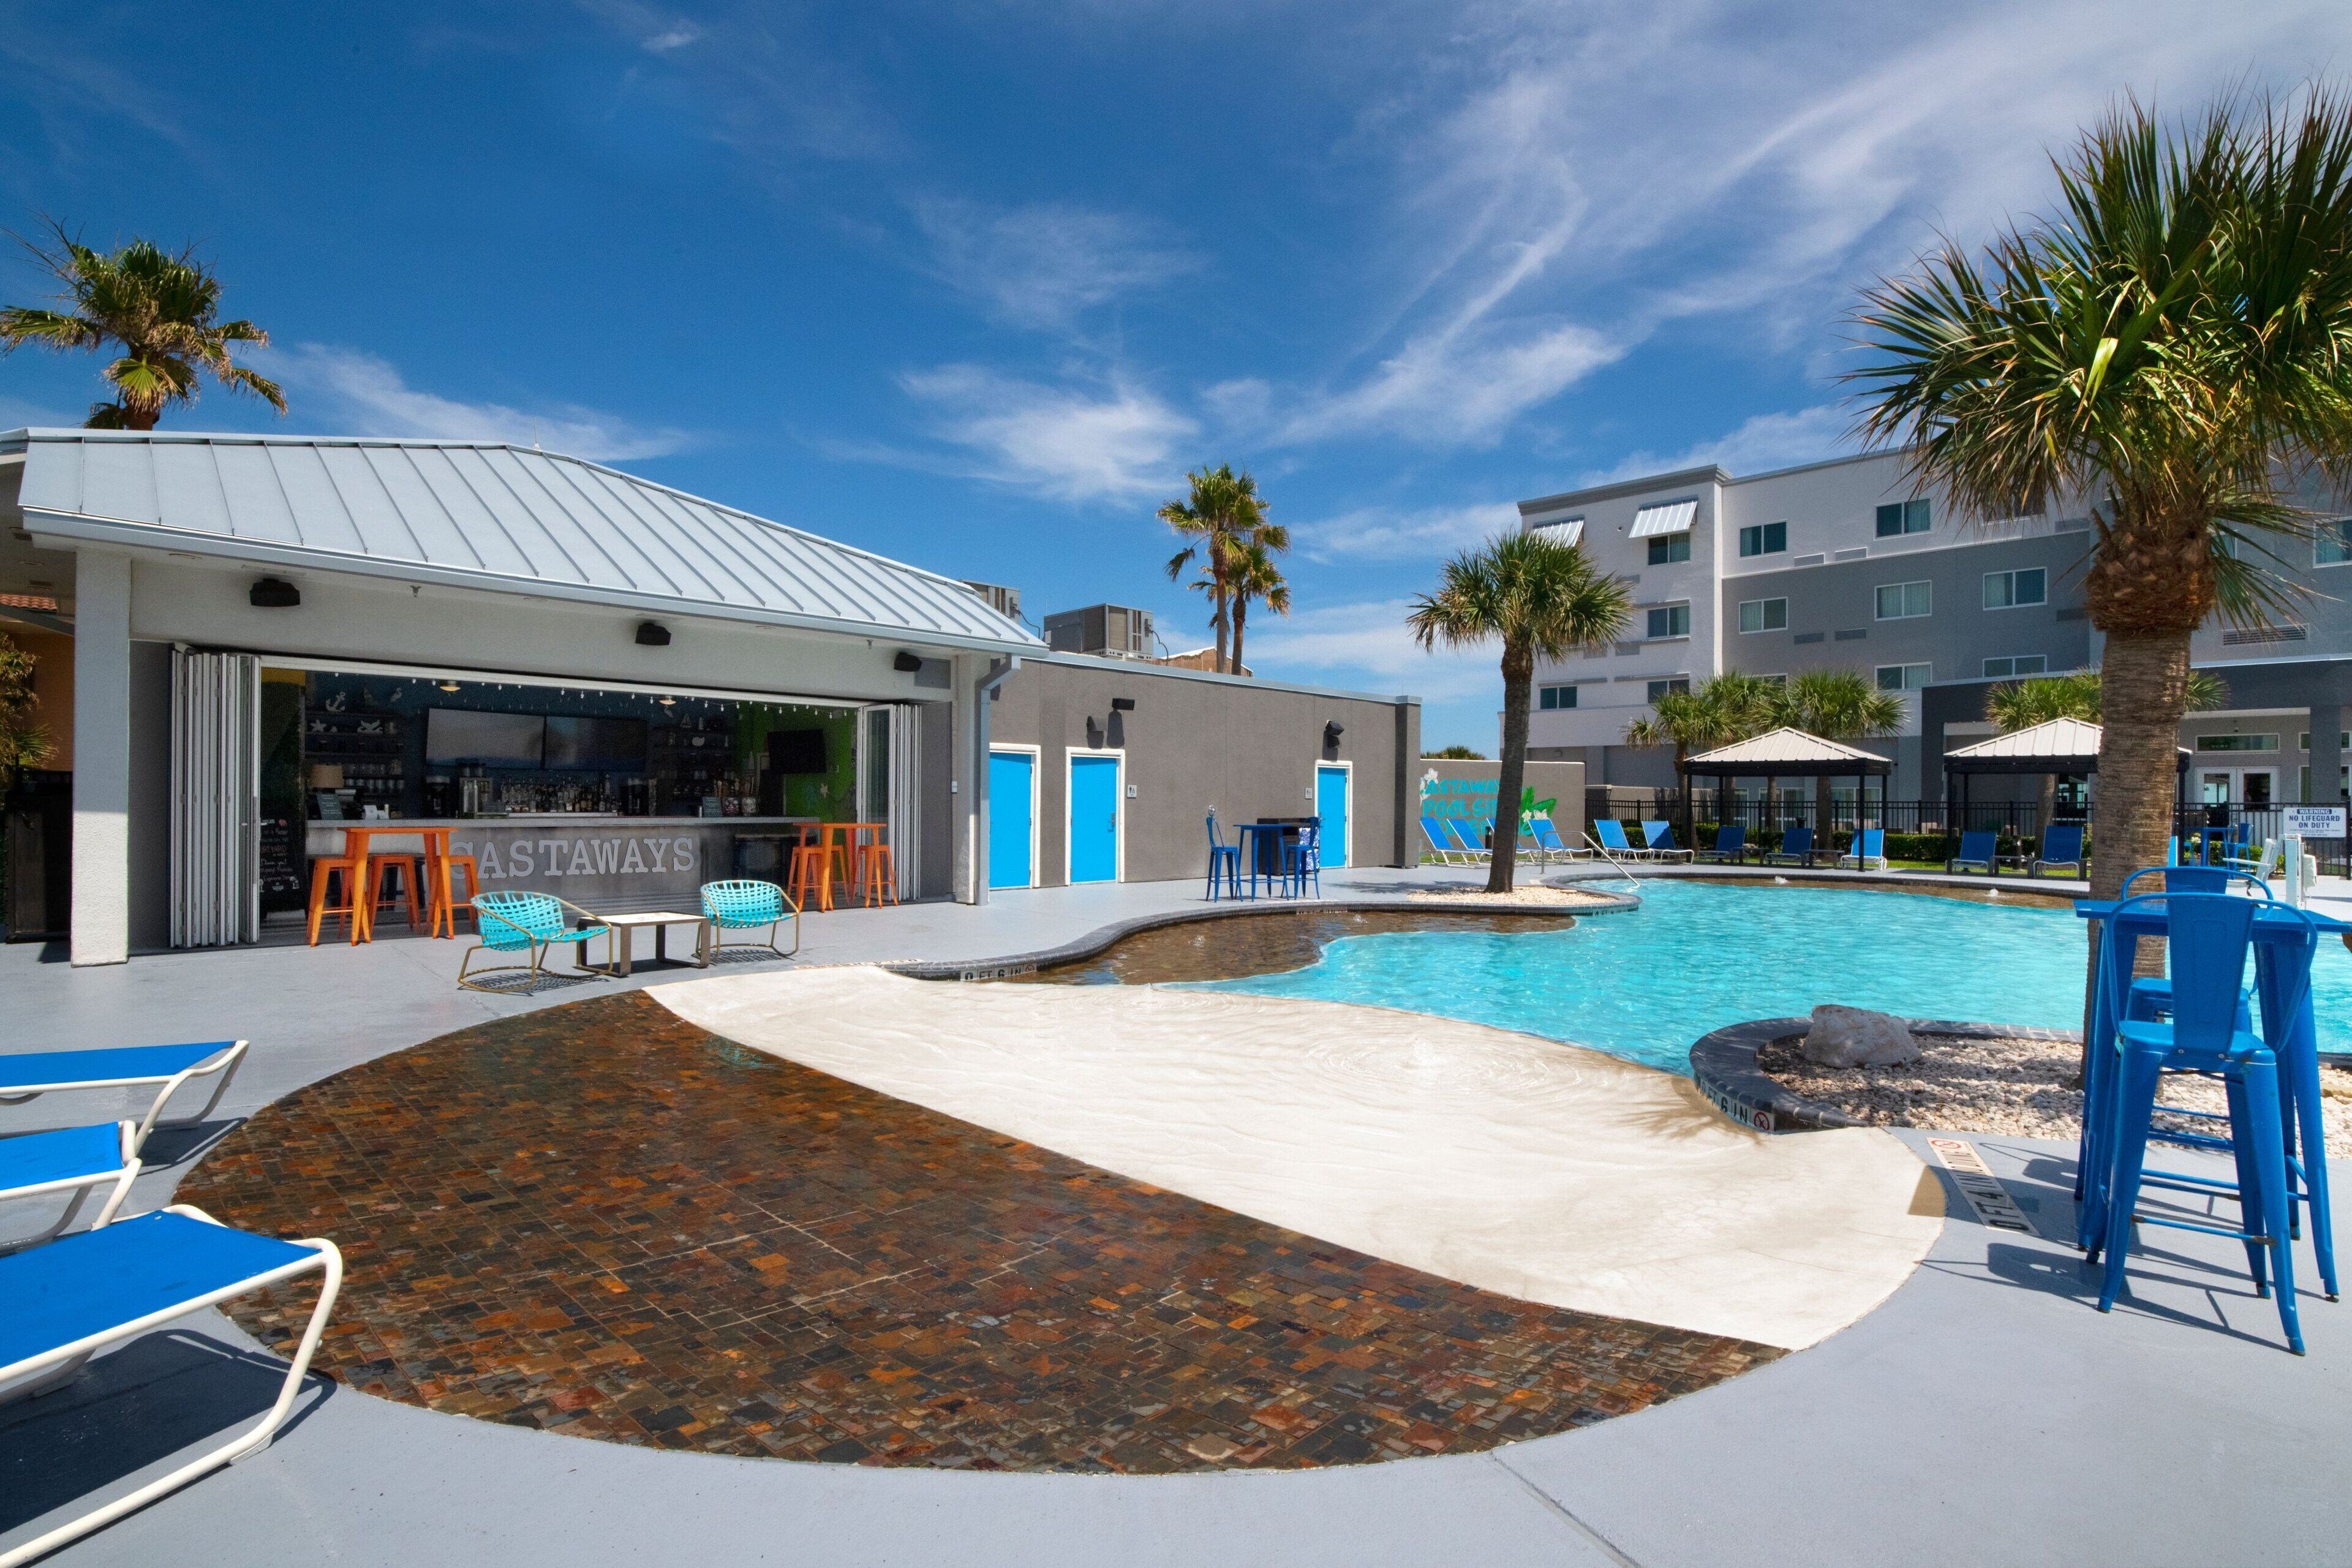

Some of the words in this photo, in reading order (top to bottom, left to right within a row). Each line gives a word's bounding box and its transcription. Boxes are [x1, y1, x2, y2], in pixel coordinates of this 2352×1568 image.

[1721, 1096, 1727, 1112] 6
[1733, 1102, 1747, 1123] IN
[1956, 1174, 1996, 1188] IN
[1967, 1190, 2004, 1200] 4
[1974, 1201, 2020, 1218] FT
[1989, 1219, 2029, 1231] 0
